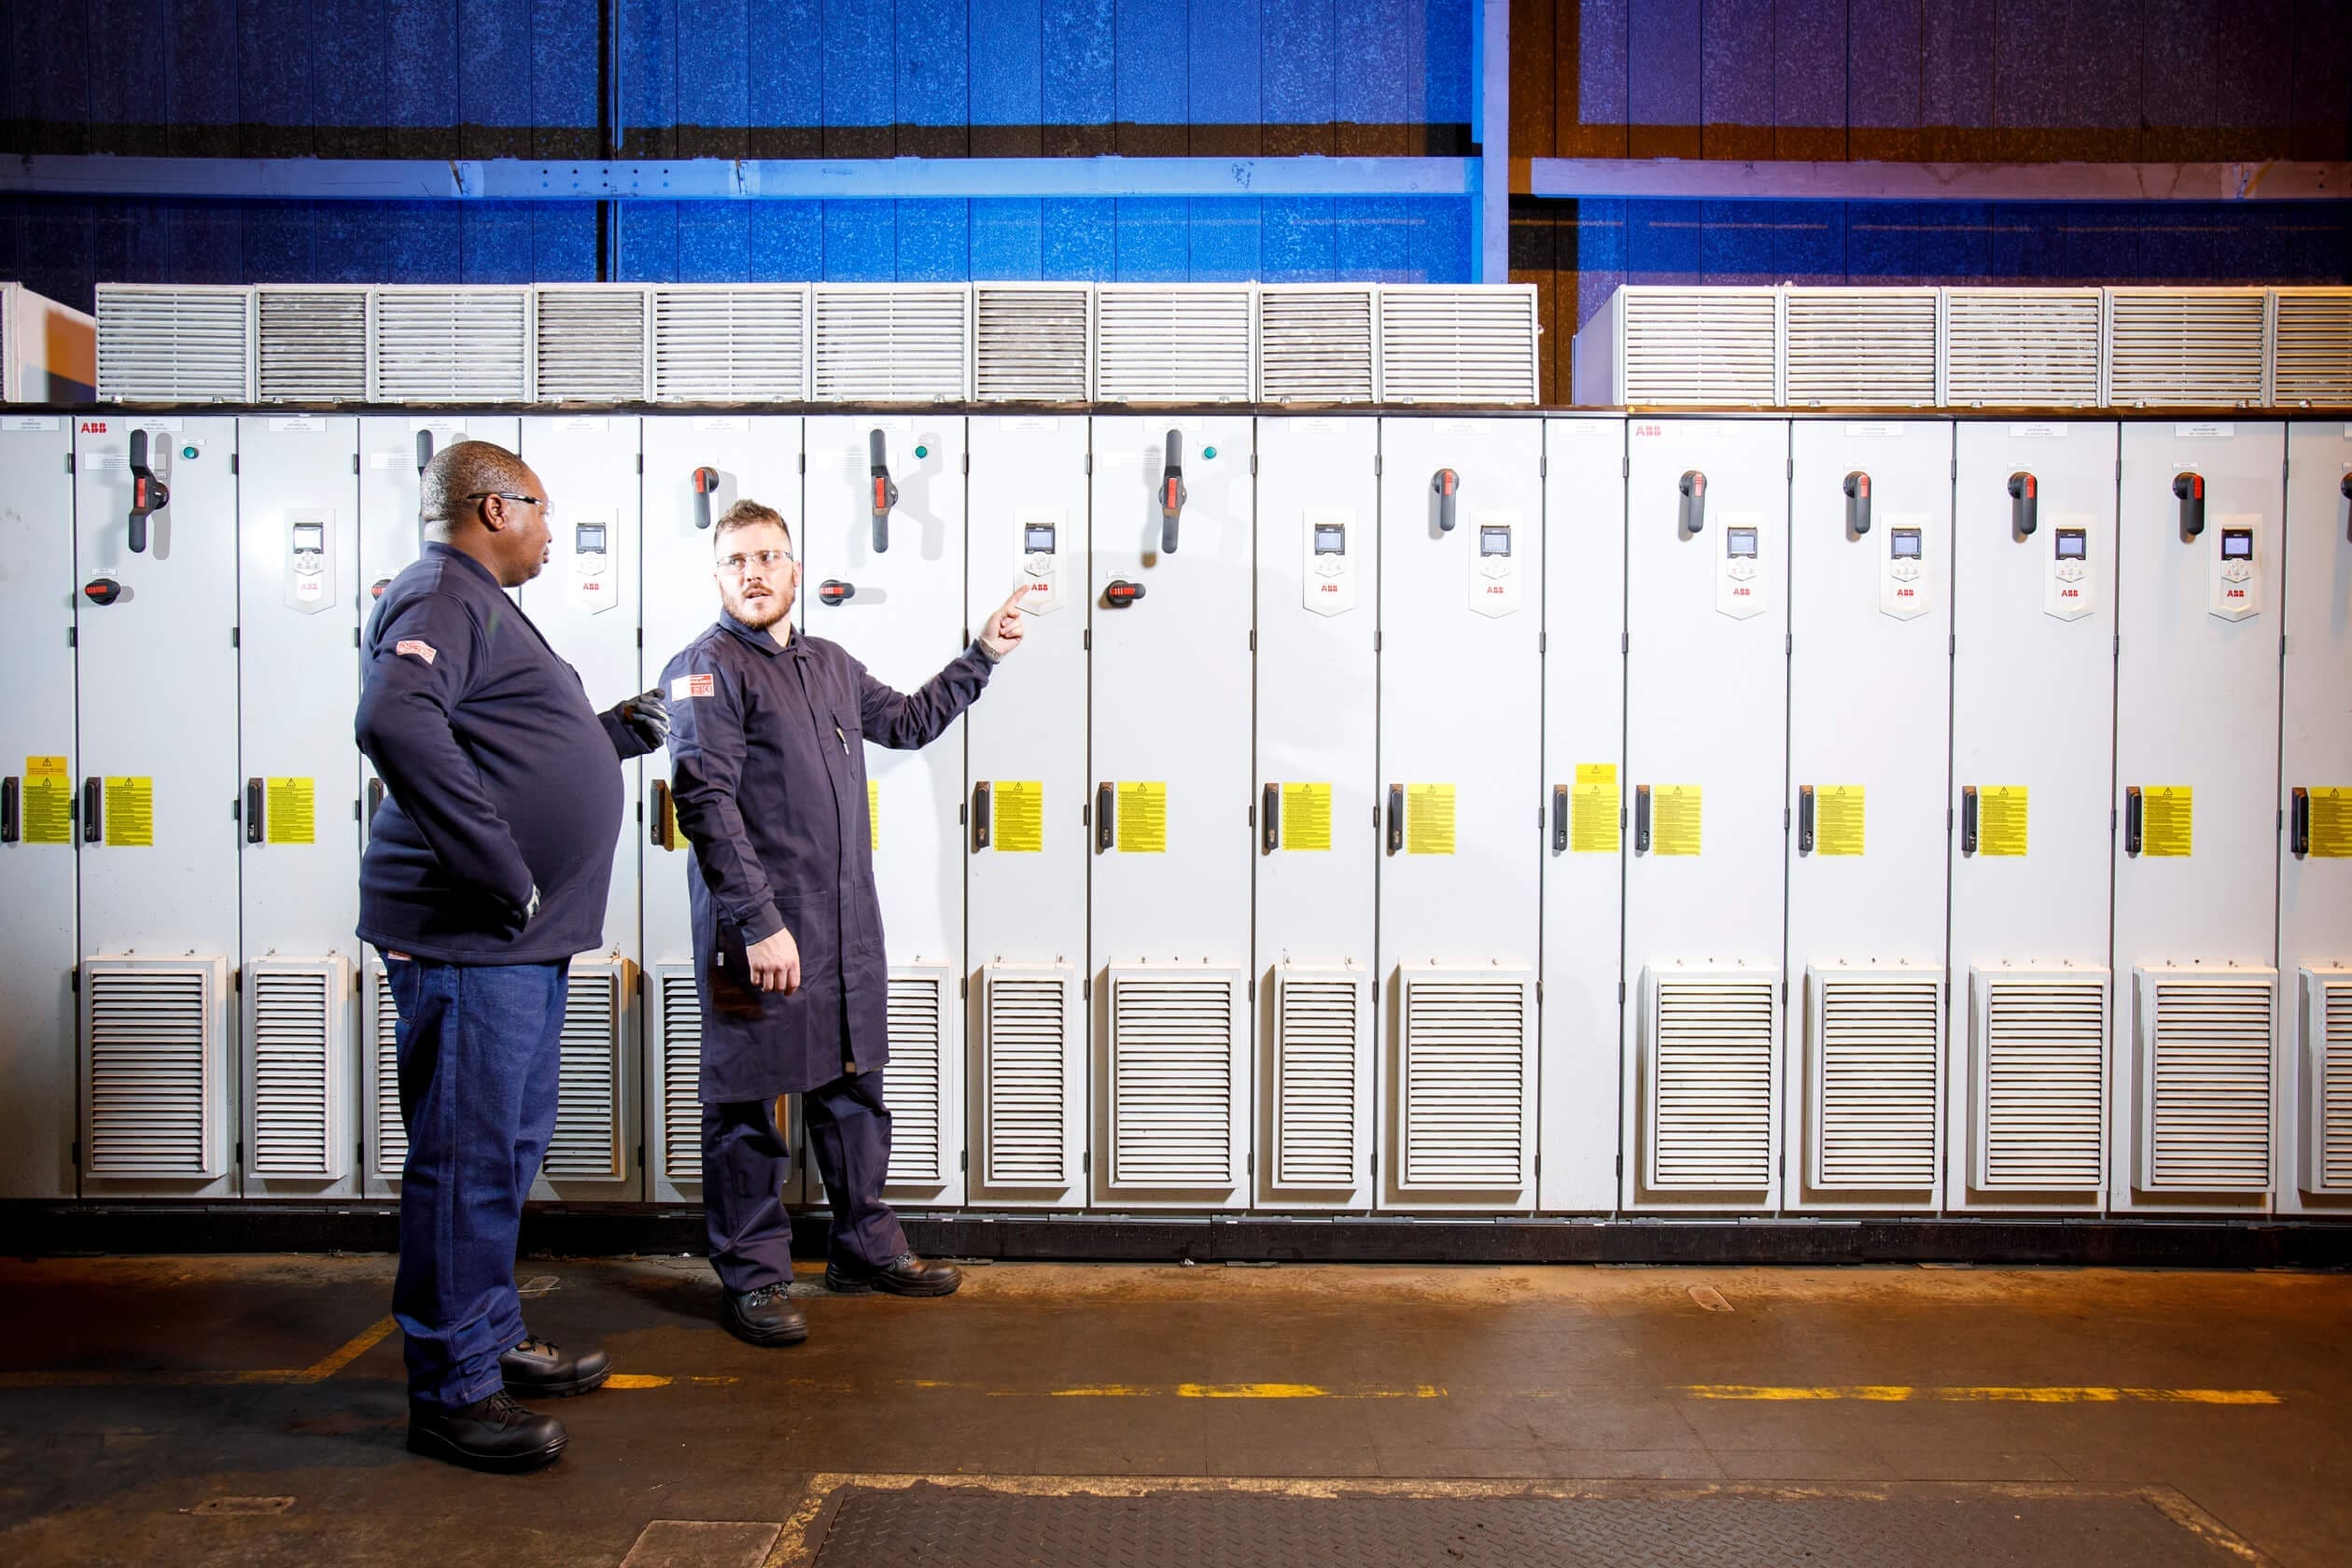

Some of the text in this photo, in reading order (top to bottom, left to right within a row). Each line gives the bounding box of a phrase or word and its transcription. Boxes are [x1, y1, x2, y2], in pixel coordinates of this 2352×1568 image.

[81, 423, 106, 434] ABB
[1636, 426, 1661, 436] ABB
[302, 582, 318, 591] ABB
[1031, 583, 1049, 592] ABB
[1488, 585, 1505, 594] ABB
[1734, 587, 1751, 595] ABB
[1897, 588, 1914, 596] ABB
